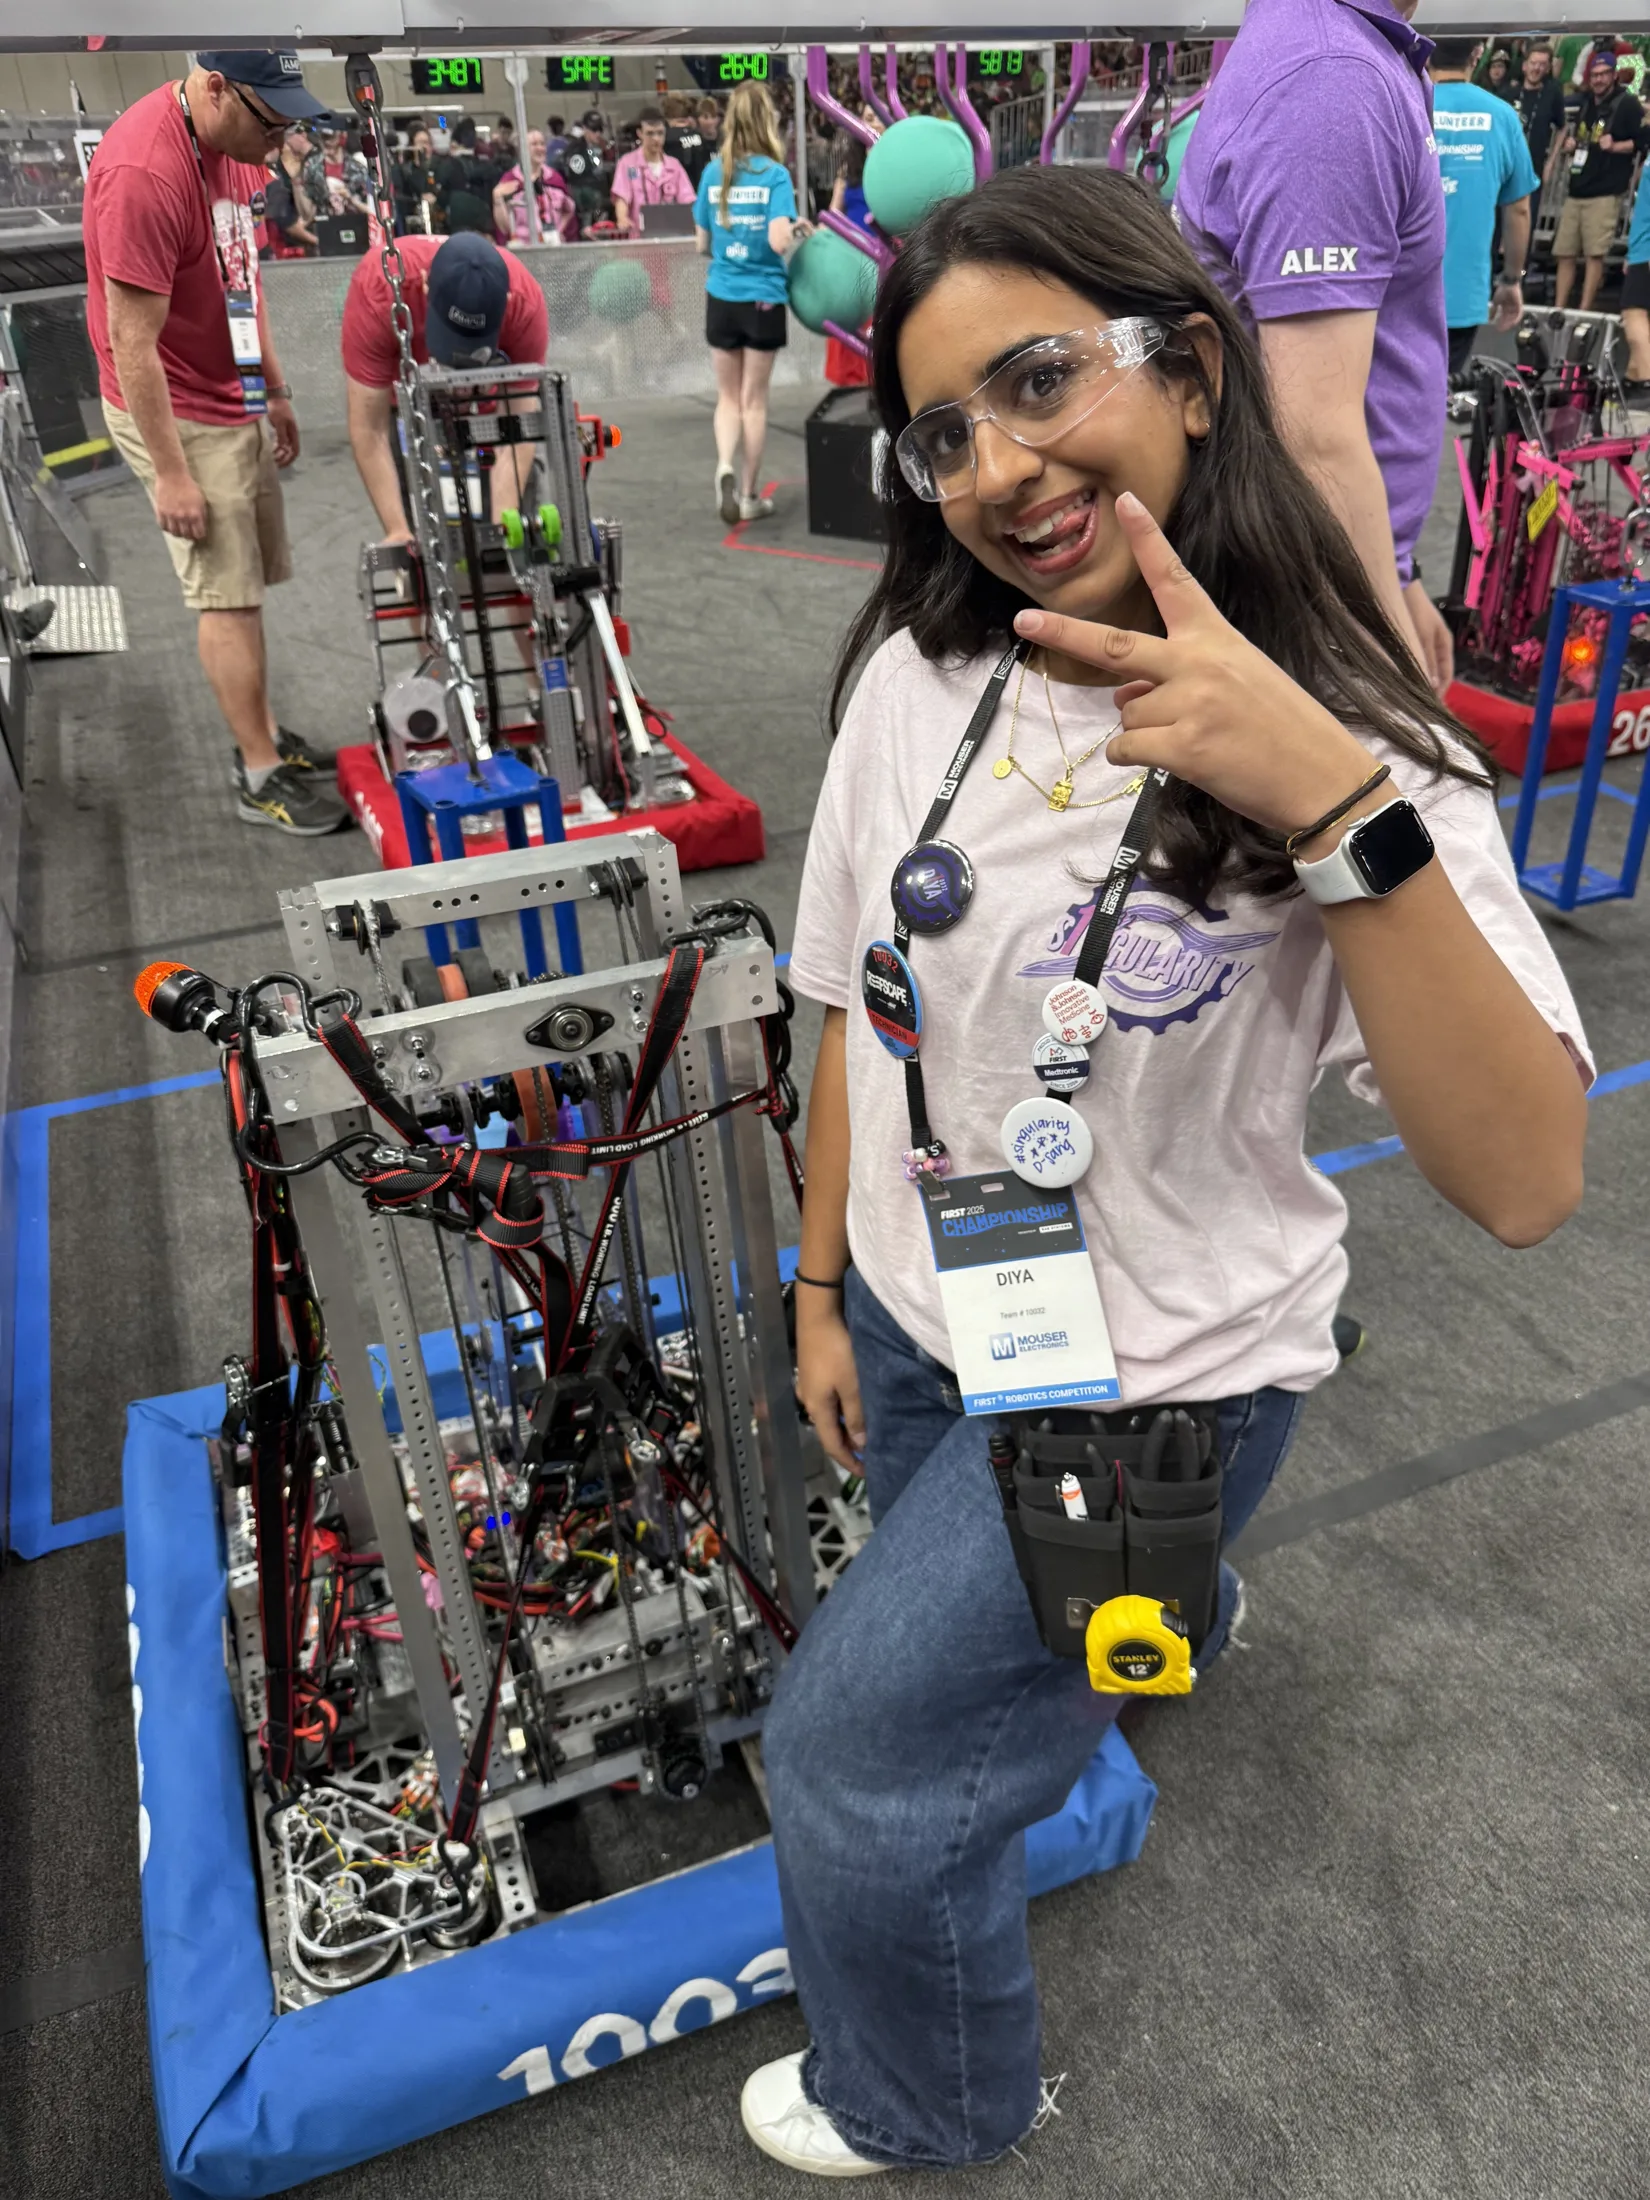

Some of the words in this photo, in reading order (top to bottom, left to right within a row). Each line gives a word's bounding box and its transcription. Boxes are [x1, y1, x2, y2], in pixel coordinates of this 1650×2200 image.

[427, 57, 481, 87] 3487
[561, 55, 611, 84] SAFE
[720, 52, 768, 80] 2640
[979, 50, 1023, 75] 5813
[1280, 246, 1359, 276] ALEX
[948, 740, 971, 778] MOUSER
[872, 950, 899, 973] 10032
[866, 970, 907, 1006] REEFSCAPE
[1049, 985, 1077, 1006] Johnson
[1054, 995, 1090, 1018] Innovative
[1058, 1003, 1090, 1025] Medicine
[1049, 1055, 1067, 1063] FIRST
[1044, 1066, 1079, 1077] Medtronic
[592, 1146, 614, 1155] LIMIT
[615, 1141, 638, 1152] LOAD
[941, 1207, 966, 1220] FIRST
[966, 1205, 985, 1216] 2025
[942, 1202, 1069, 1237] CHAMPIONSHIP
[591, 1239, 609, 1279] WORKING
[996, 1269, 1034, 1286] DIYA
[584, 1280, 597, 1303] LOAD
[578, 1303, 590, 1326] LIMIT
[1000, 1311, 1018, 1319] Team
[1025, 1307, 1046, 1316] 10032
[1017, 1331, 1068, 1346] MOUSER
[1019, 1341, 1069, 1352] ELECTRONICS
[1005, 1391, 1047, 1404] ROBOTICS
[1048, 1385, 1108, 1399] COMPETITION
[1112, 1654, 1160, 1663] STANLEY
